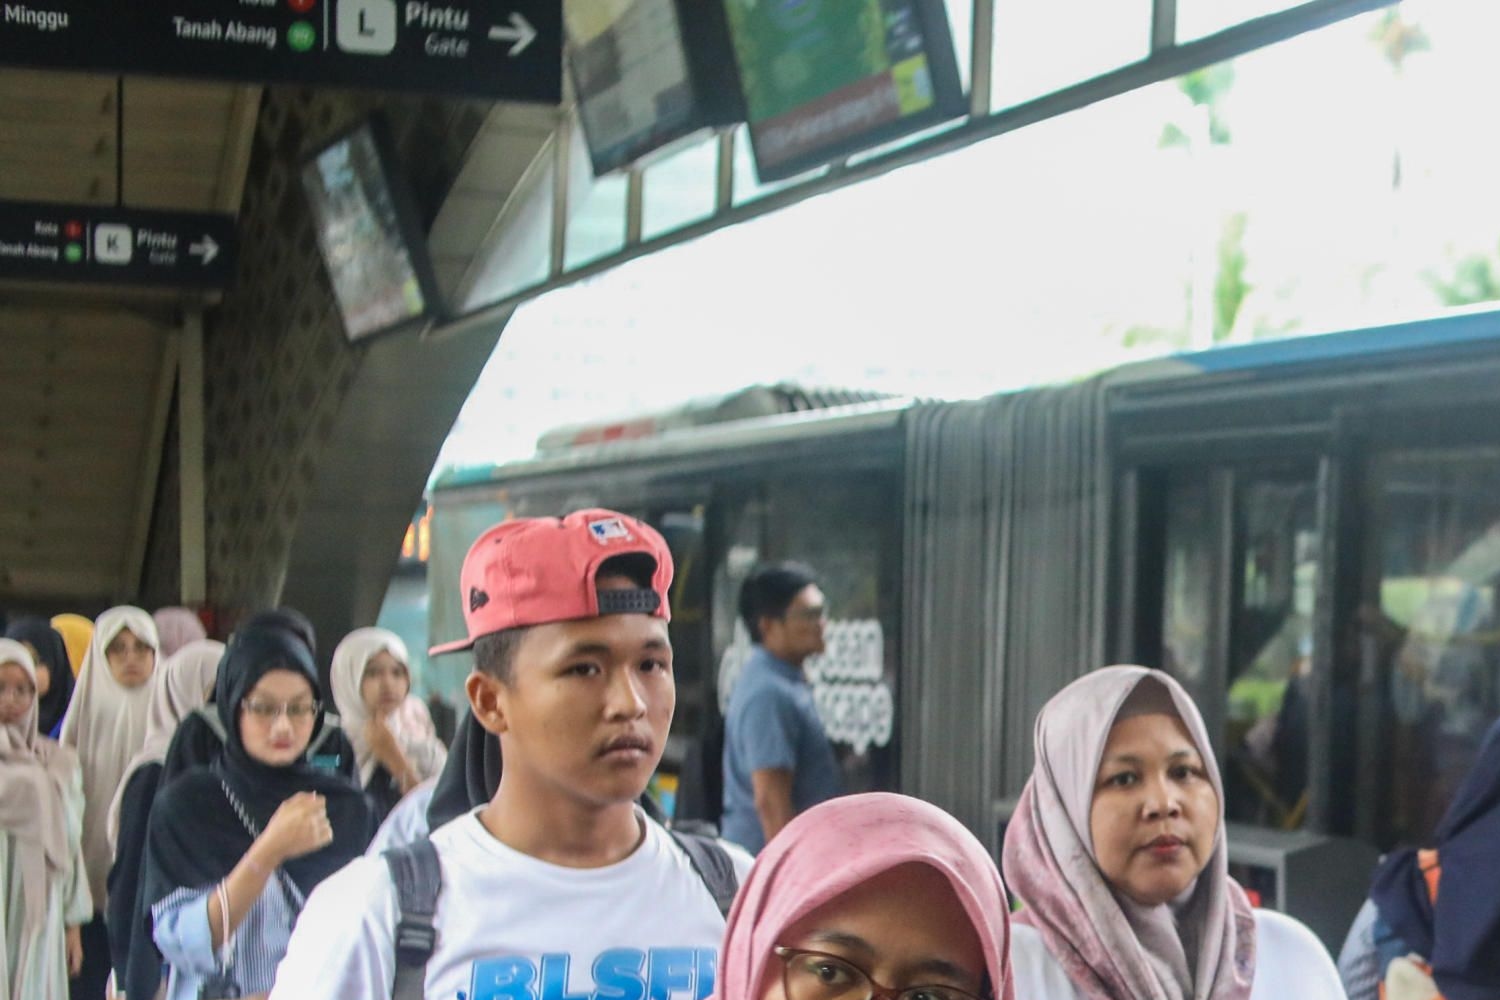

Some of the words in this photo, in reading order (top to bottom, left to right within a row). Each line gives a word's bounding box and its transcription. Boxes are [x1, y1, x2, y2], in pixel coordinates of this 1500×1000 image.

[5, 5, 69, 31] Minggu
[358, 8, 376, 37] L
[404, 2, 469, 31] Pintu
[173, 16, 222, 40] Tanah
[224, 20, 277, 49] Abang
[424, 33, 469, 58] Gate
[106, 233, 119, 251] K
